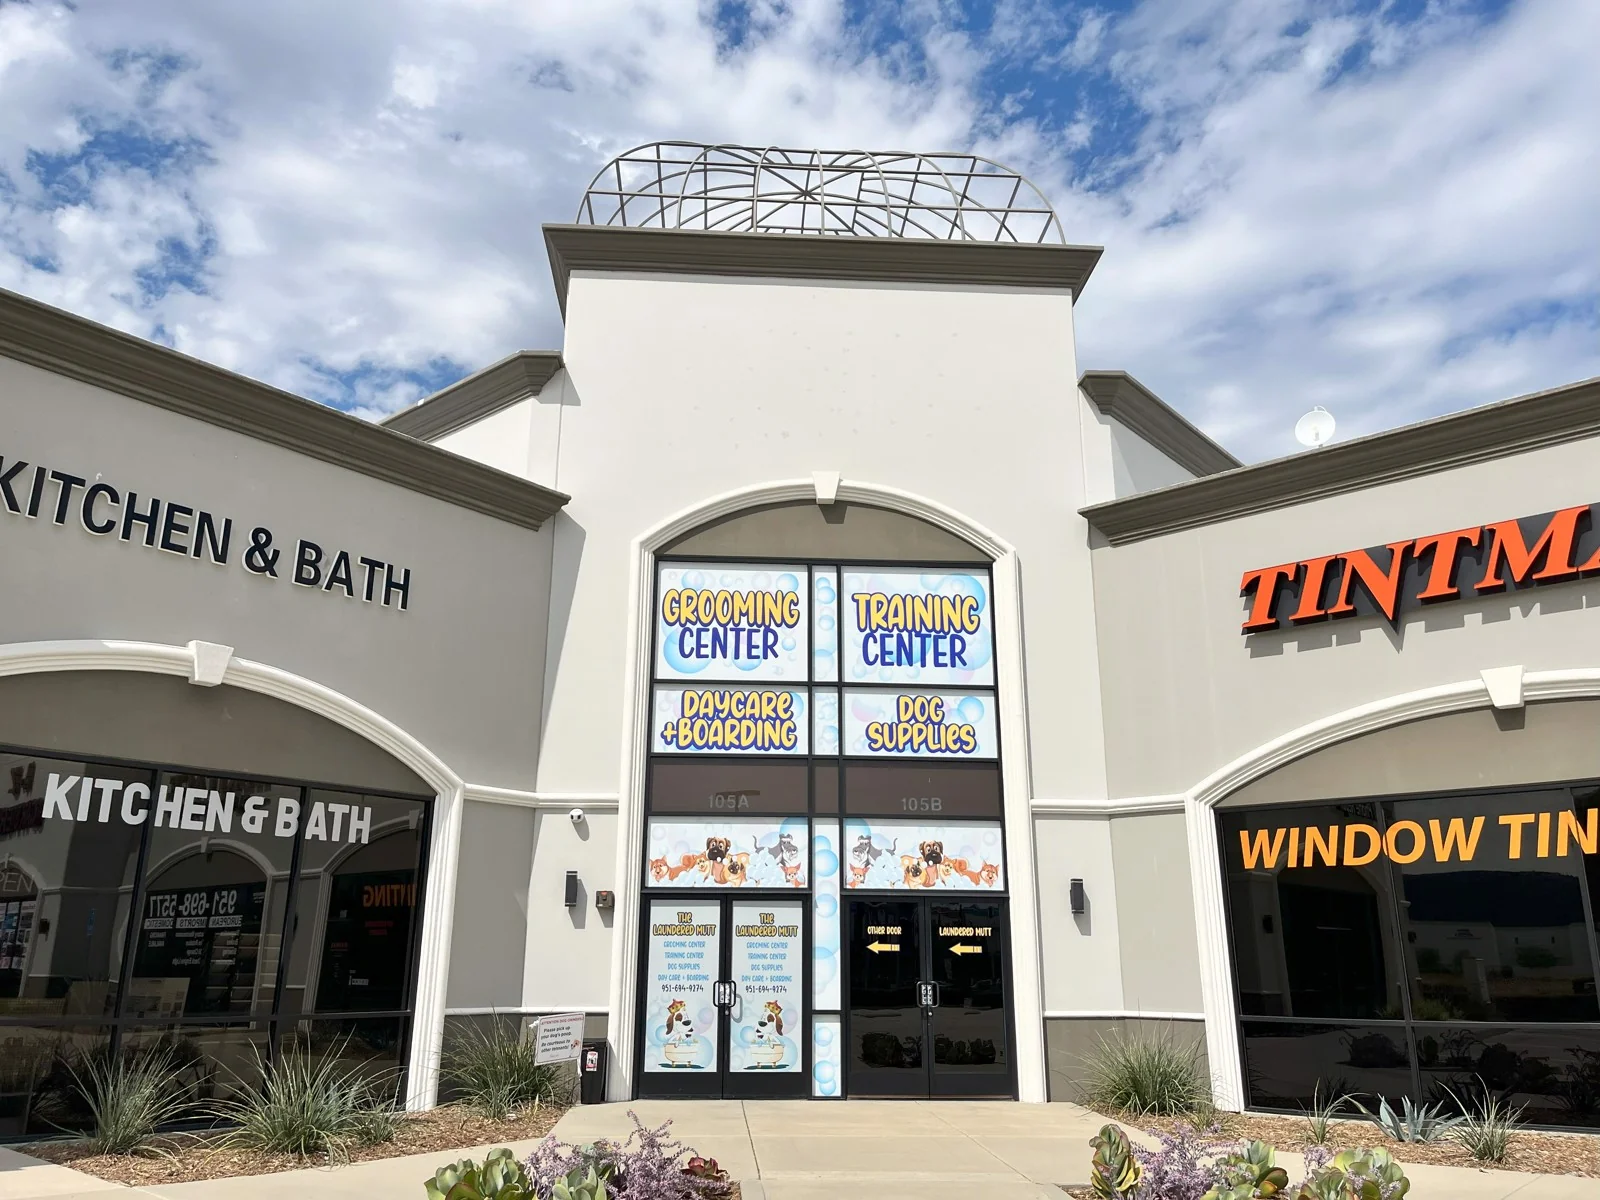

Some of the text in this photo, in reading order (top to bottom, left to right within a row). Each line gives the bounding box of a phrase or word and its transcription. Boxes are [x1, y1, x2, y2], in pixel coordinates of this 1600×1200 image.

[0, 455, 412, 611] KITCHEN & BATH
[1240, 504, 1600, 634] TINTM
[662, 588, 800, 628] GROOMING
[852, 592, 981, 634] TRAINING
[679, 625, 779, 660] CENTER
[862, 632, 968, 668] CENTER
[897, 695, 945, 724] DOG
[661, 718, 798, 751] +BOARDING
[865, 721, 978, 753] SUPPLIES
[41, 772, 235, 833] KITCHEN
[241, 796, 269, 834] &
[274, 797, 372, 844] BATH
[708, 794, 749, 810] 105A
[901, 797, 943, 812] 105B
[1239, 808, 1599, 869] WINDOW TIN
[677, 912, 693, 924] THE
[759, 913, 775, 924] THE
[653, 924, 716, 936] LAUNDERED MUTT
[735, 925, 798, 937] LAUNDERED MUTT
[867, 926, 902, 935] OTHER DOOR
[939, 927, 992, 937] LAUNDERED MUTT
[678, 963, 700, 971] SUPPLIES
[661, 984, 704, 993] 951-694-9274
[745, 985, 788, 994] 951-694-9274
